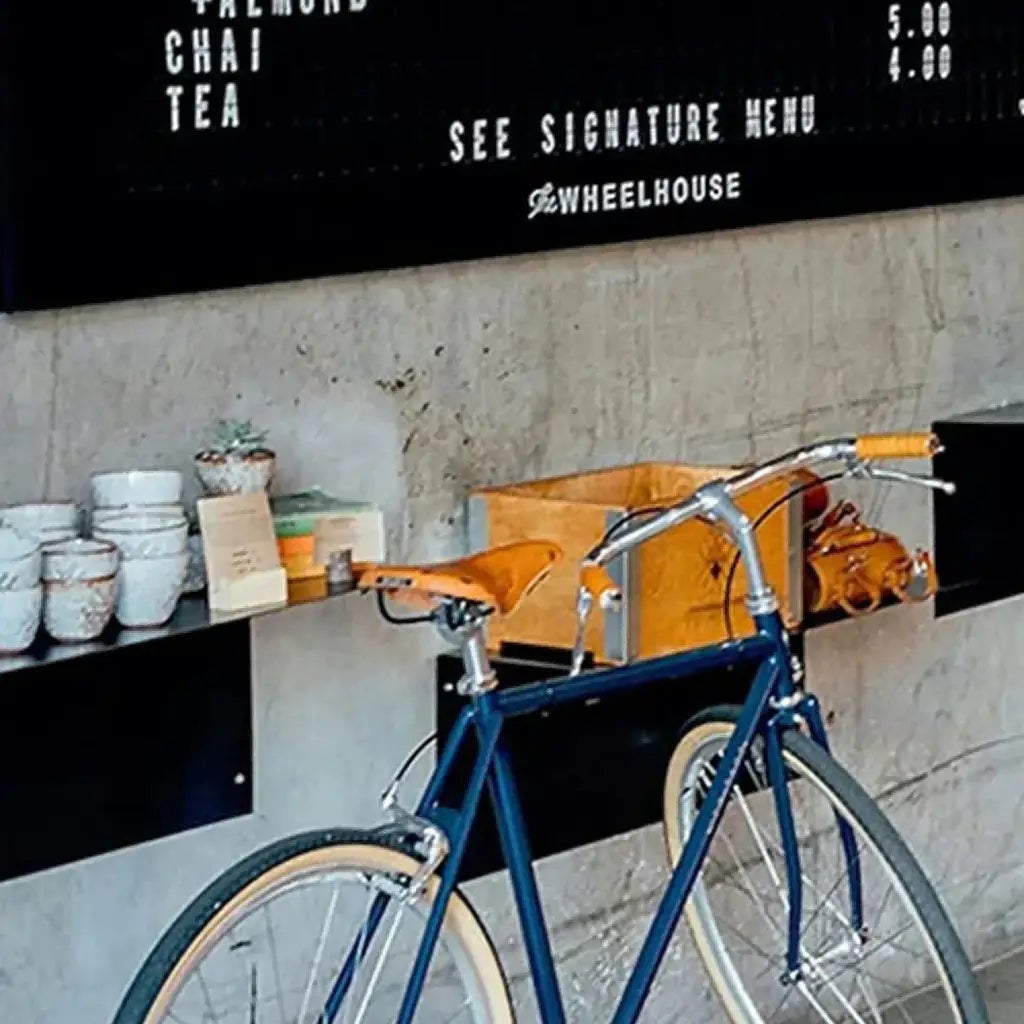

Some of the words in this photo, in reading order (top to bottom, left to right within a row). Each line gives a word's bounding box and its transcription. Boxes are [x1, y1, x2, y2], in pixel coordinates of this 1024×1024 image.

[888, 2, 950, 40] 5.00
[165, 28, 260, 74] CHAI
[889, 44, 951, 82] 4.00
[166, 83, 239, 131] TEA
[450, 117, 510, 162] SEE
[541, 102, 719, 154] SIGNATURE
[746, 95, 814, 138] MENU
[558, 172, 741, 215] WHEELHOUSE
